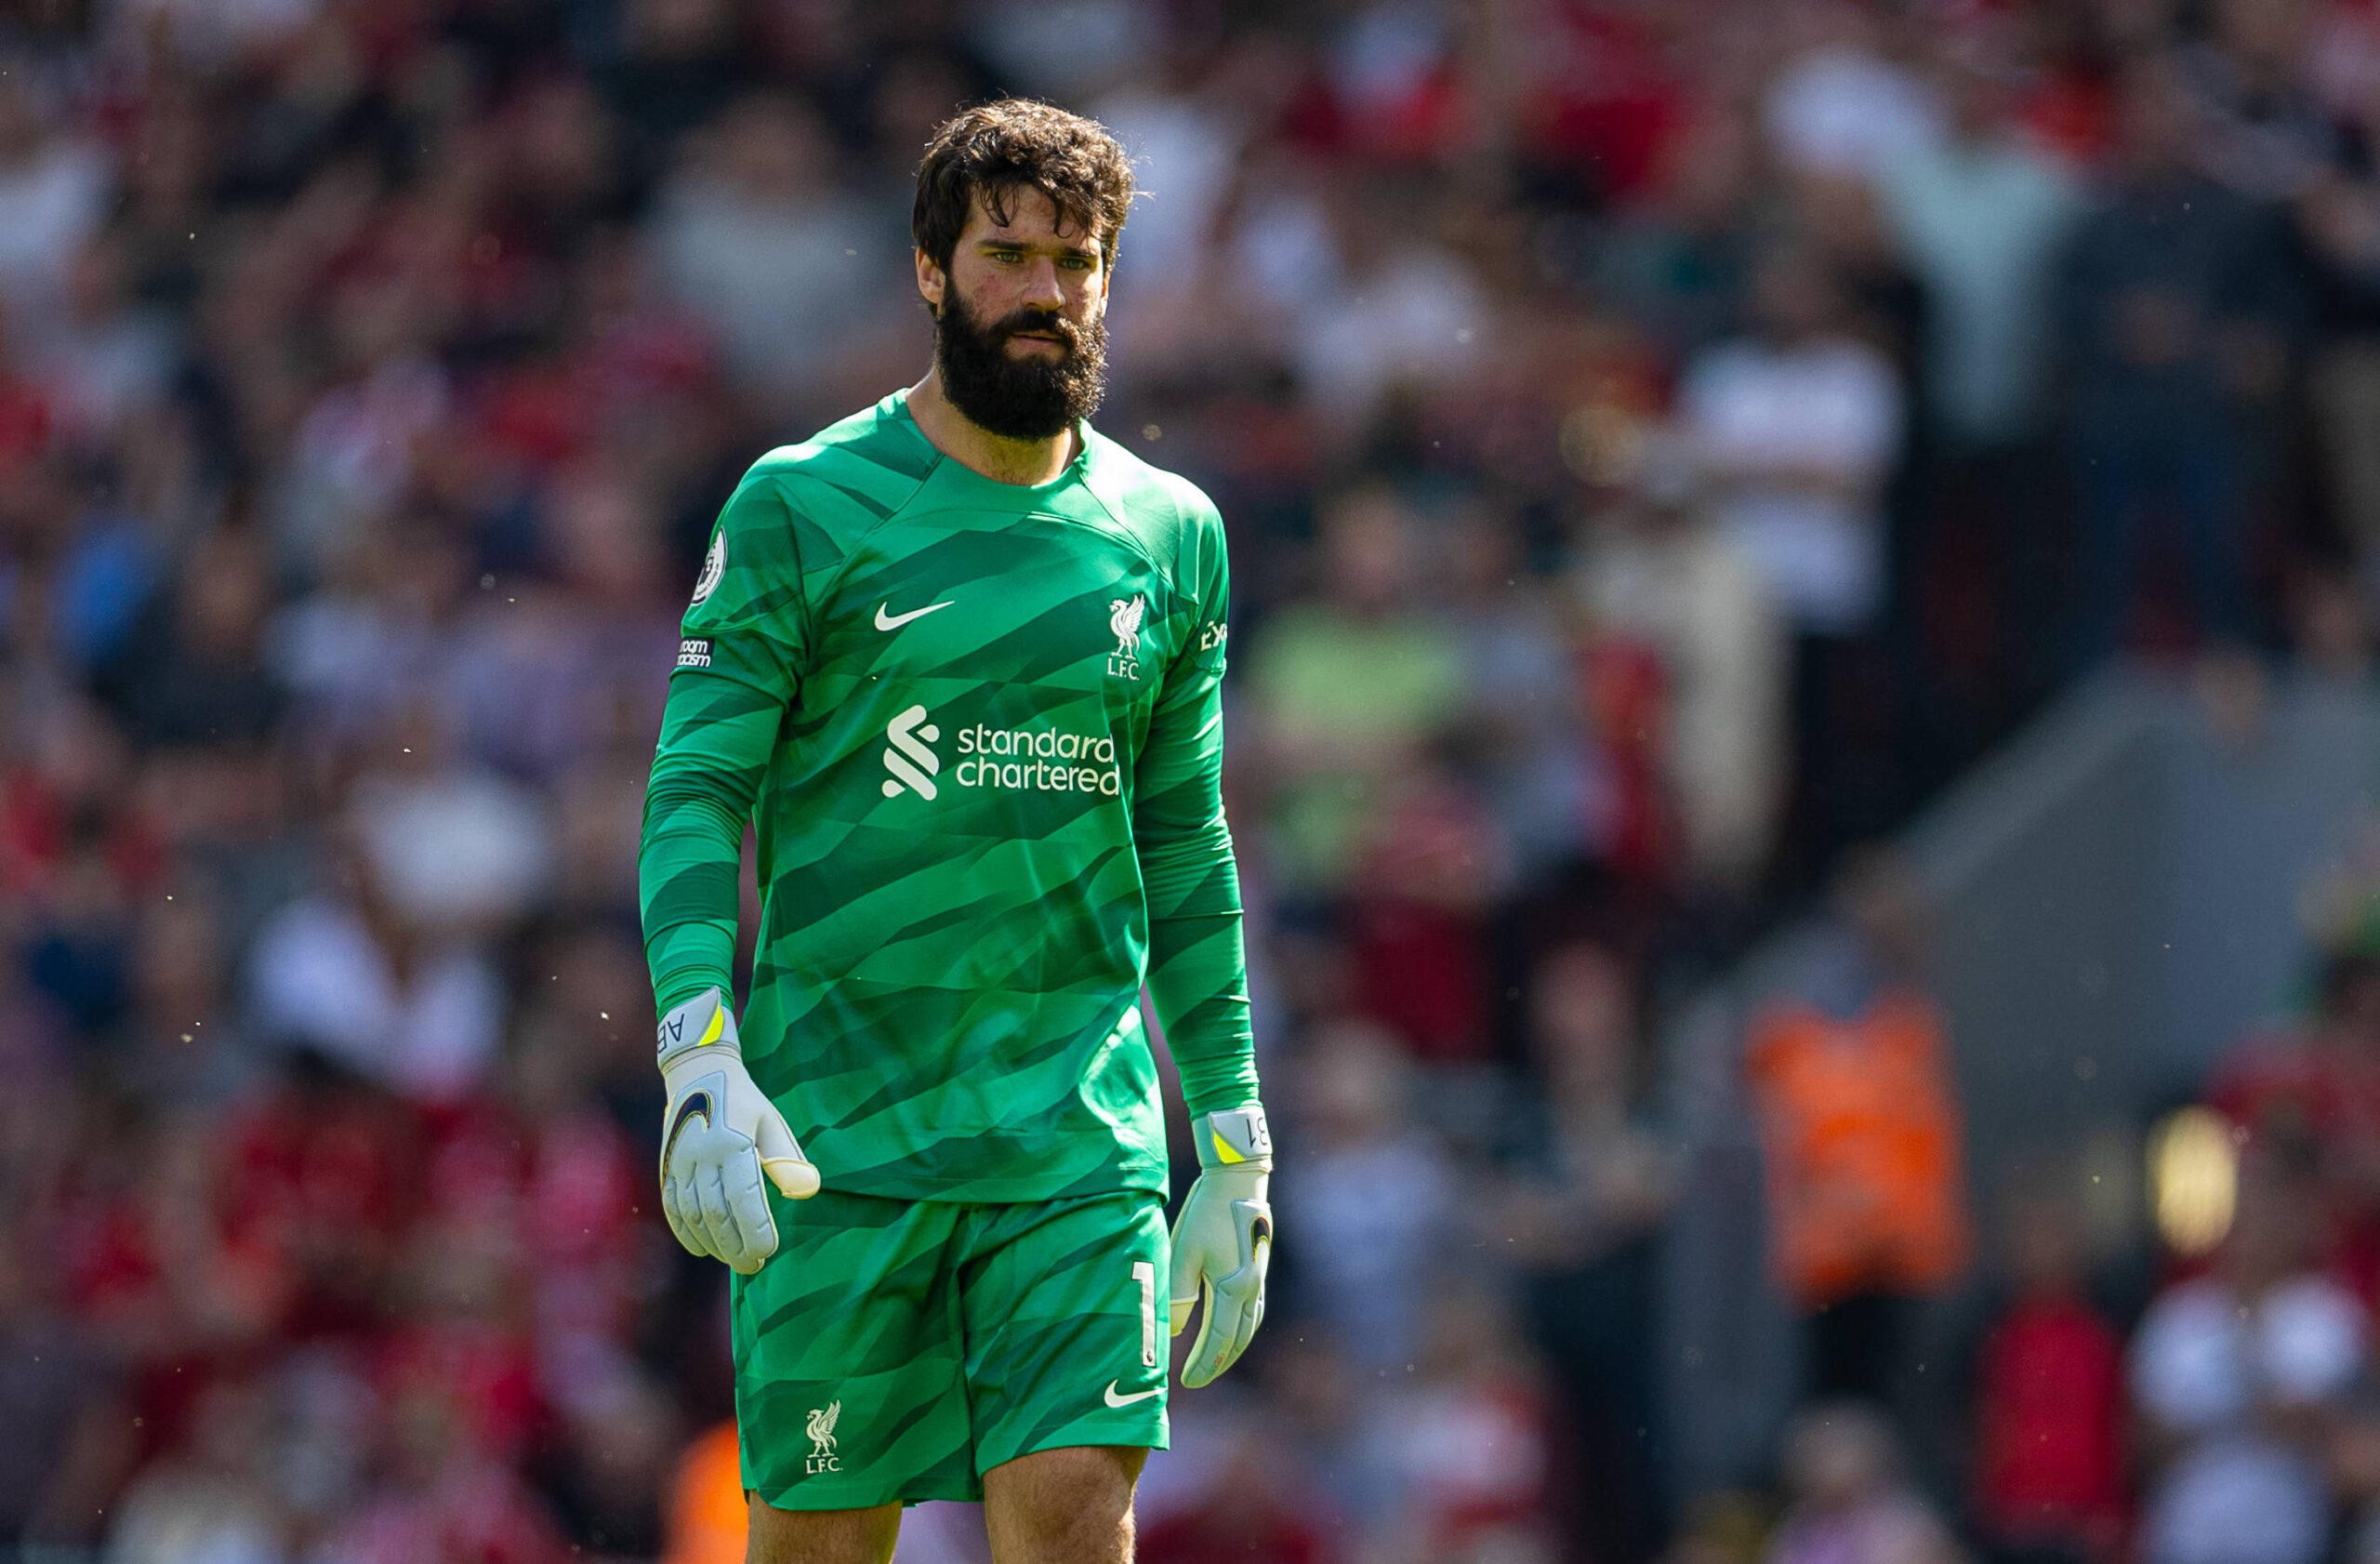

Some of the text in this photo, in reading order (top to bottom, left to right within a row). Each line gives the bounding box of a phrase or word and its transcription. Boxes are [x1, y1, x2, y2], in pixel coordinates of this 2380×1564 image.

[958, 722, 1115, 763] standard
[956, 756, 1120, 796] chartered
[1130, 1260, 1157, 1368] 1
[805, 1457, 844, 1474] L.F.C.
